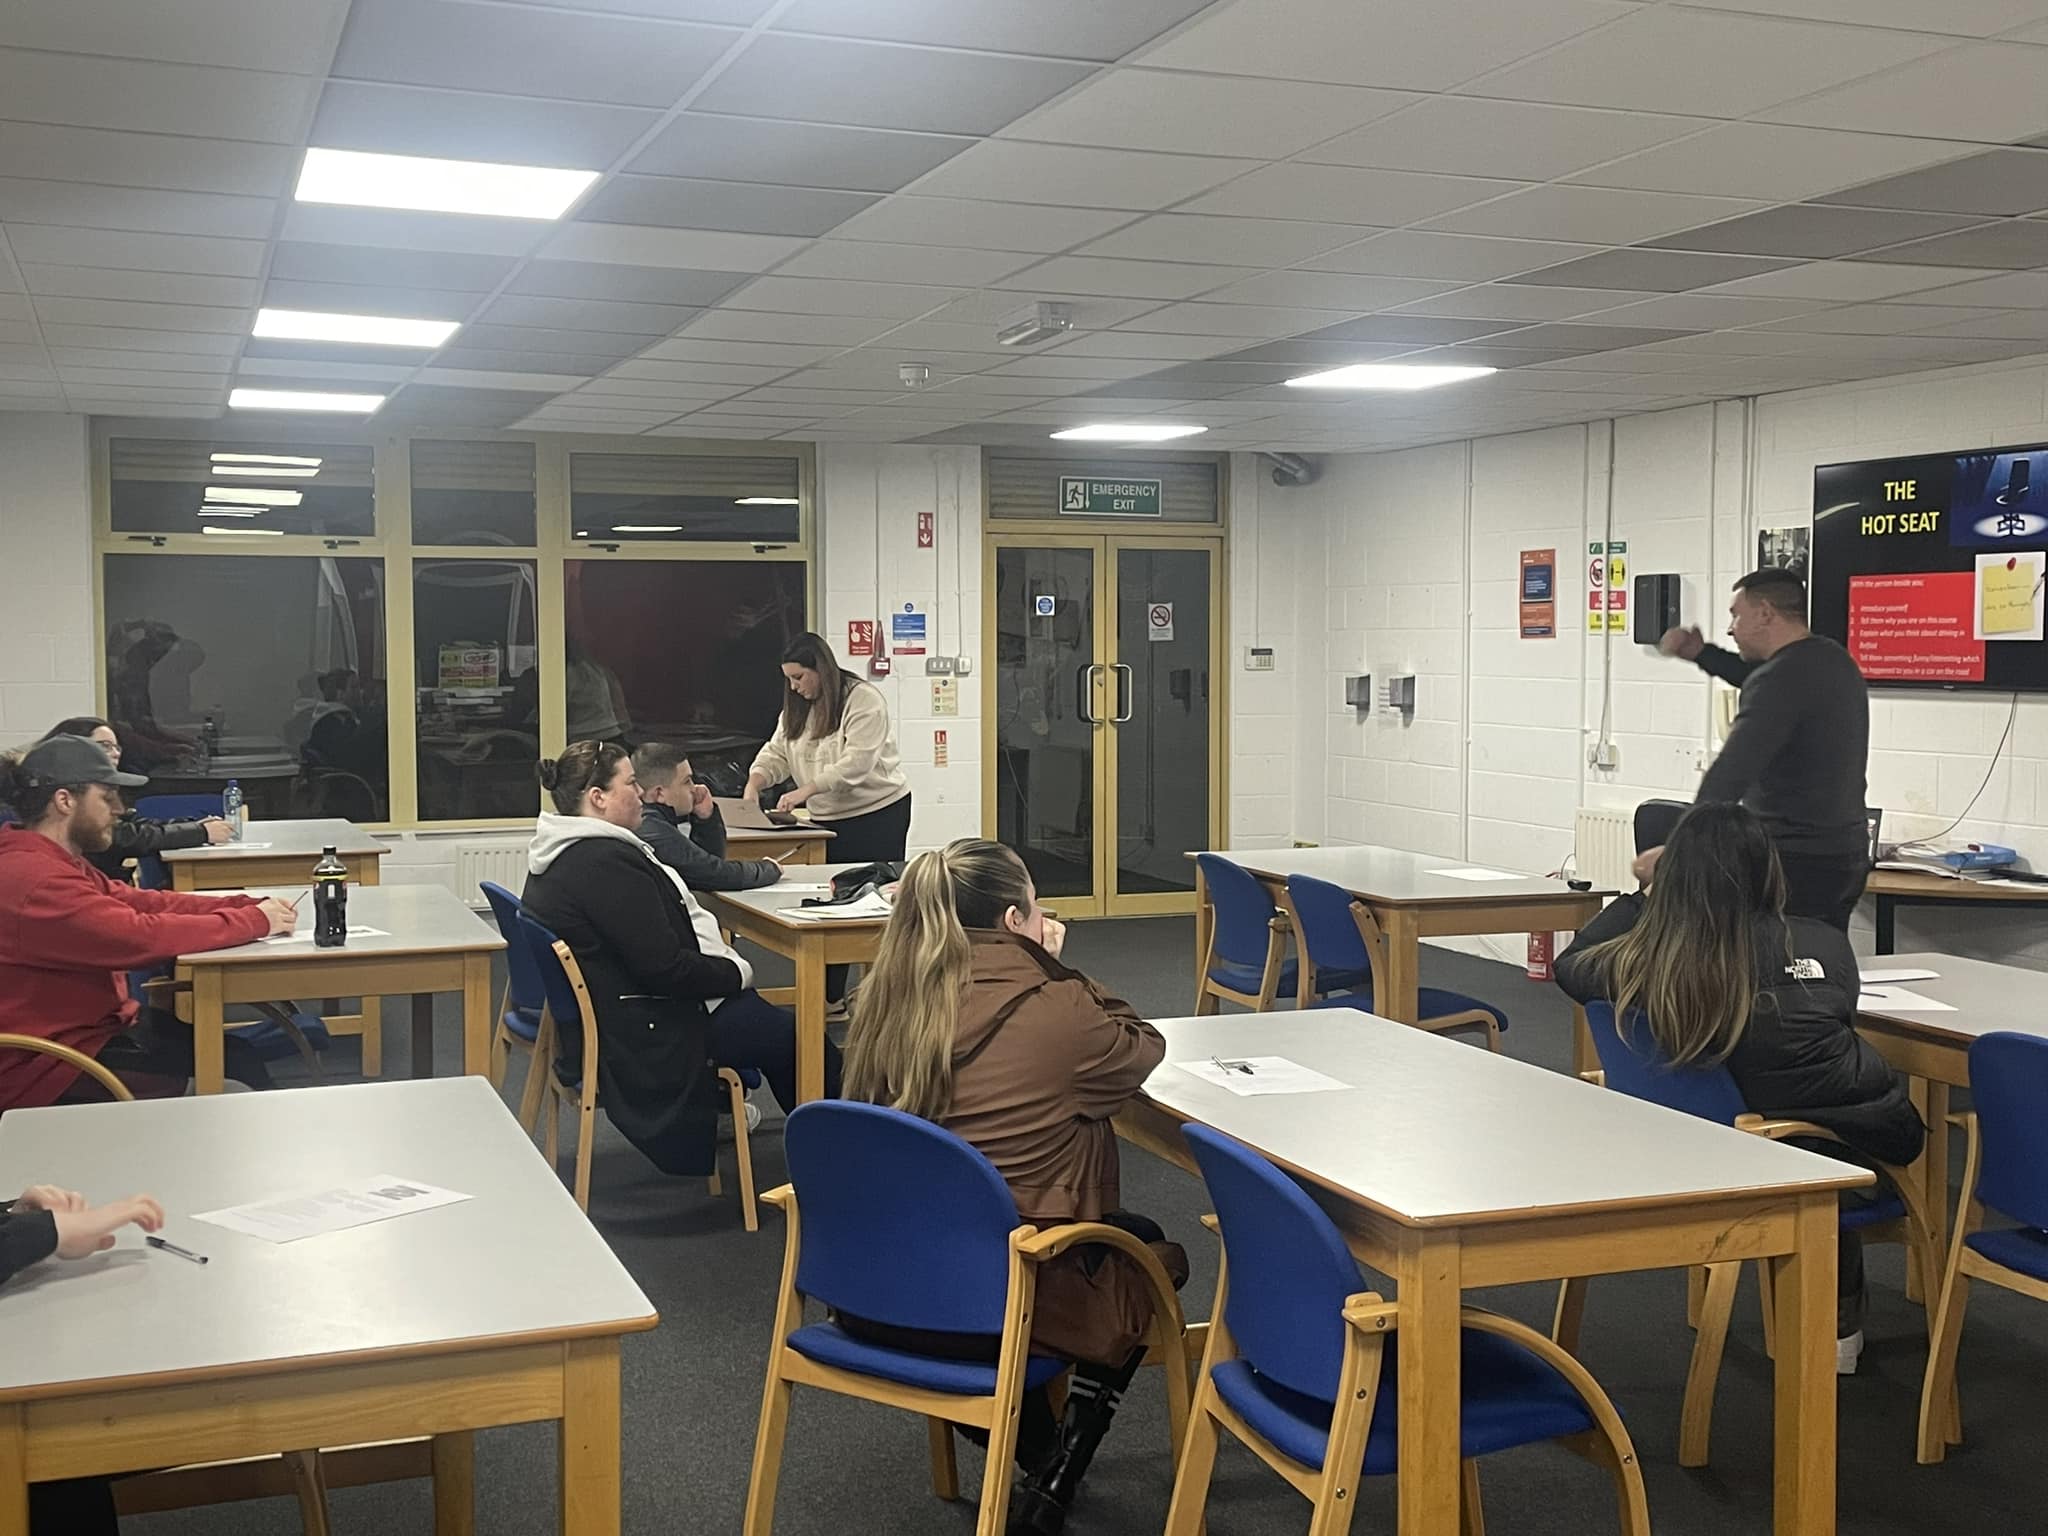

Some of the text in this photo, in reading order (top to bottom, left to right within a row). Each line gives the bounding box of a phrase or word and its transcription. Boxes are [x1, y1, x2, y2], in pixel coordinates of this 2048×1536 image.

[1092, 483, 1156, 497] EMERGENCY
[1884, 480, 1916, 501] THE
[1113, 499, 1136, 511] EXIT
[1862, 511, 1940, 535] HOT SEAT
[1885, 603, 1909, 614] yourself
[1860, 616, 1869, 625] Tell
[1870, 616, 1884, 625] them
[1885, 616, 1897, 626] why
[1896, 617, 1907, 626] you
[1908, 617, 1918, 625] are
[1880, 629, 1894, 637] what
[1894, 630, 1905, 638] you
[1784, 965, 1809, 974] NORTH
